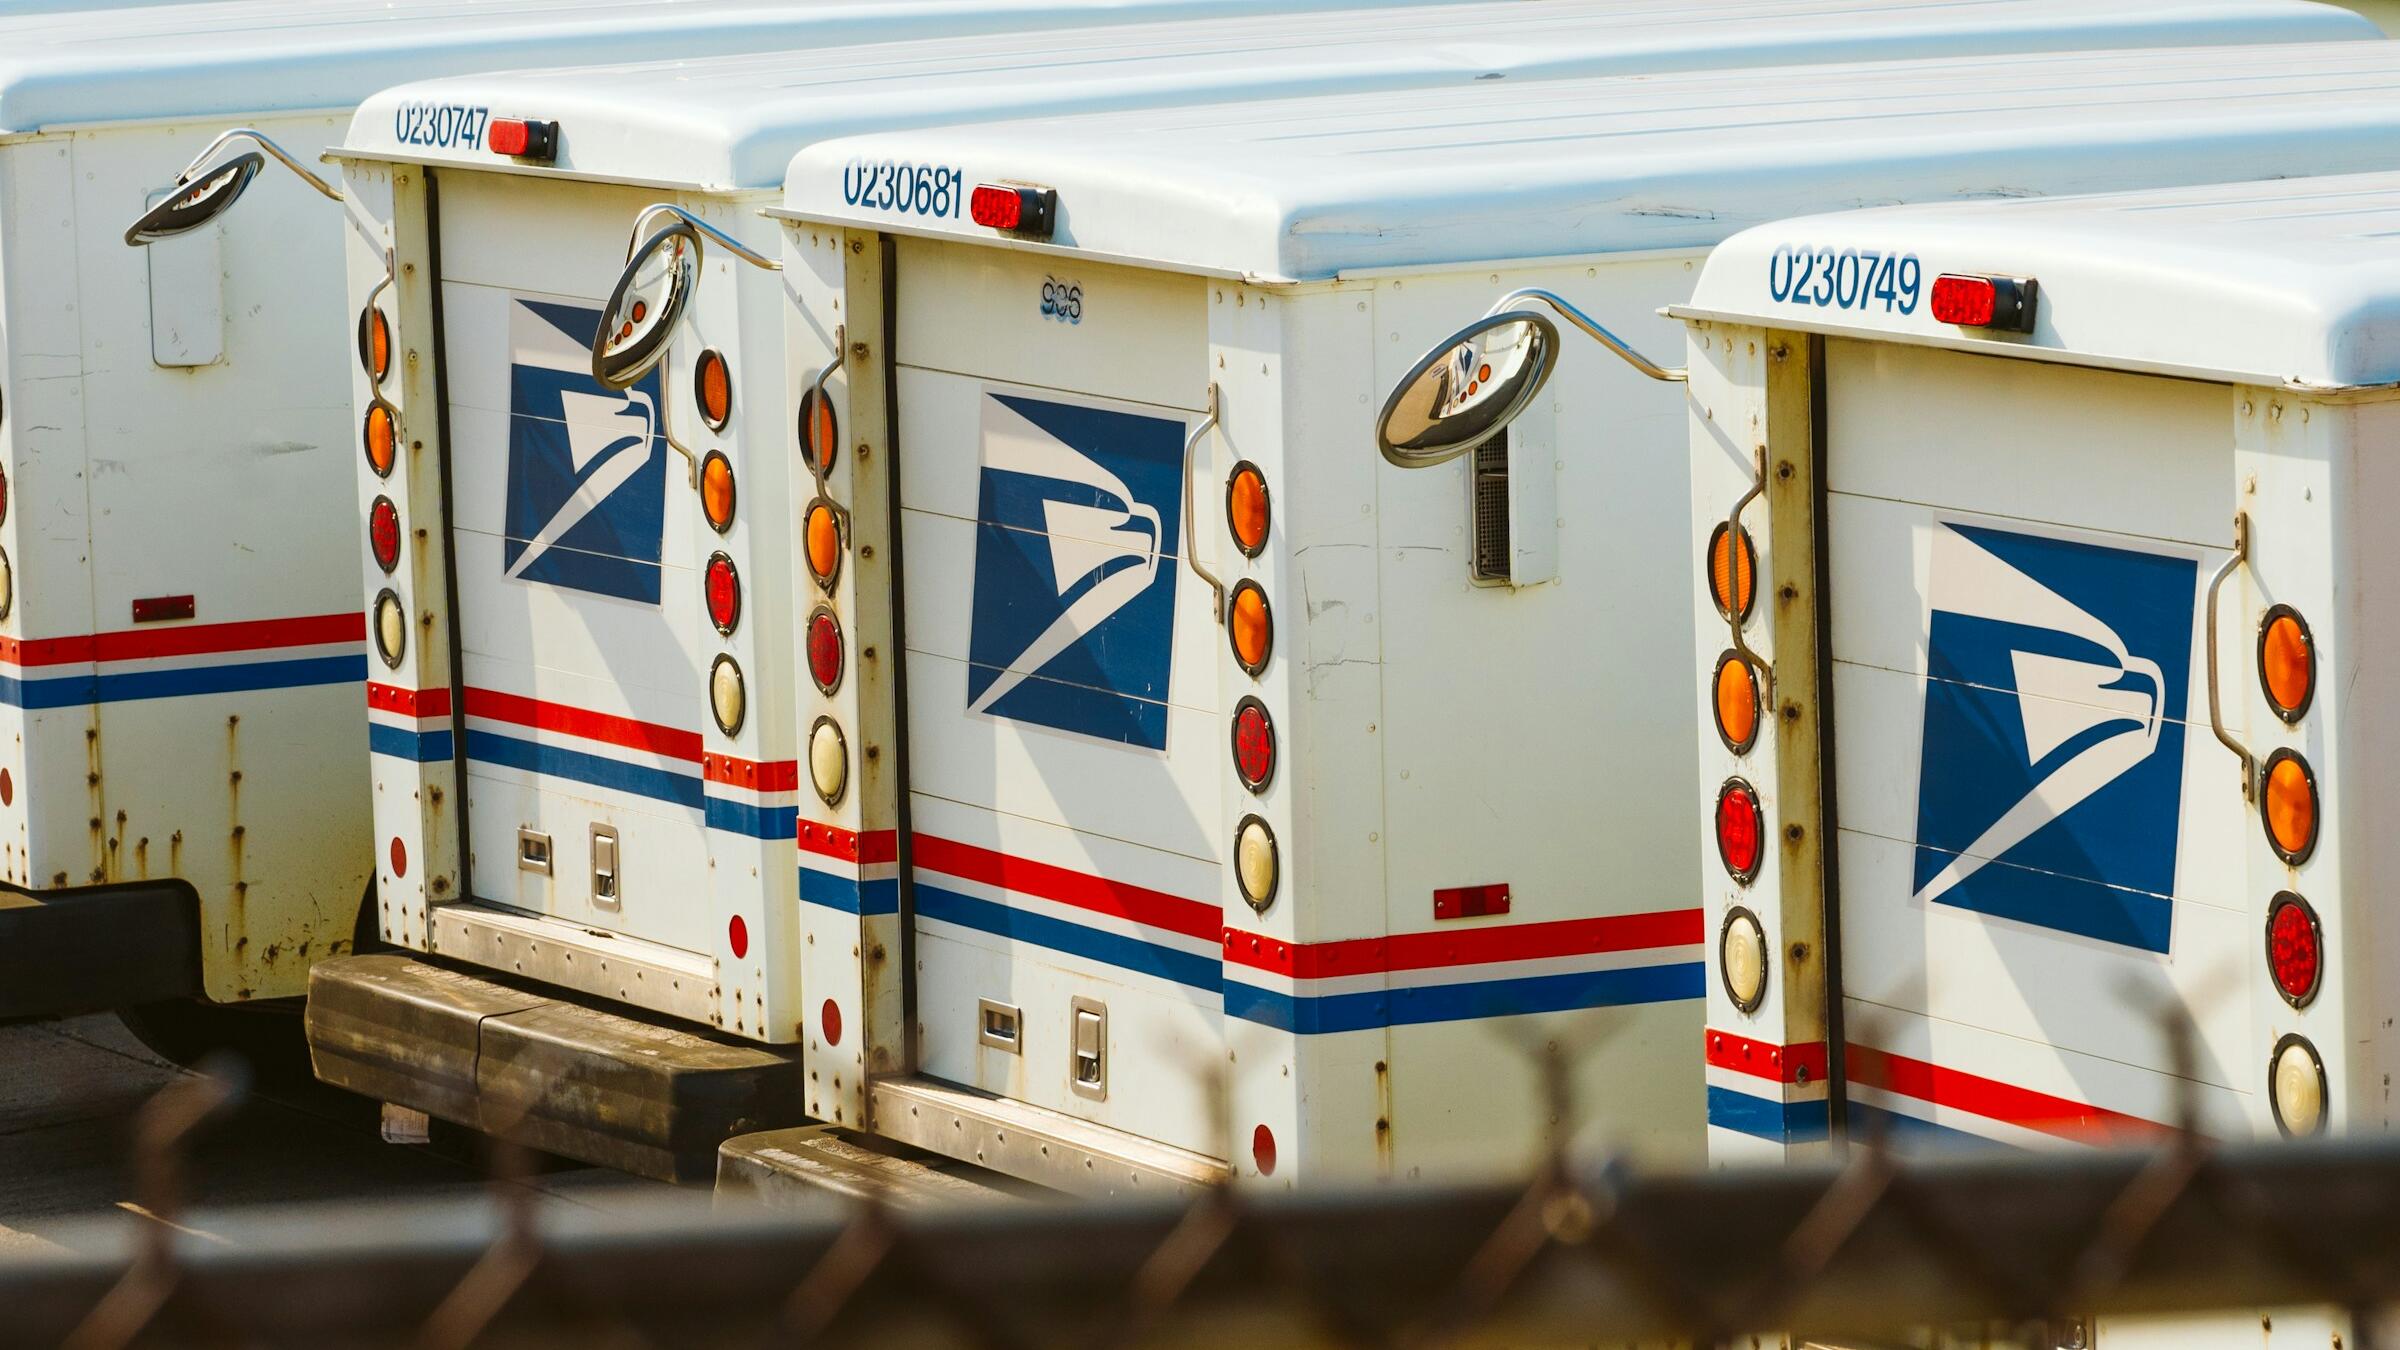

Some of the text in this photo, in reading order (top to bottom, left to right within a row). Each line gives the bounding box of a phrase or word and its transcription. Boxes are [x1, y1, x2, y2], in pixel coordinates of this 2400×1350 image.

[396, 101, 489, 150] 0230747
[844, 156, 962, 219] 0230681
[1770, 243, 1921, 316] 0230749
